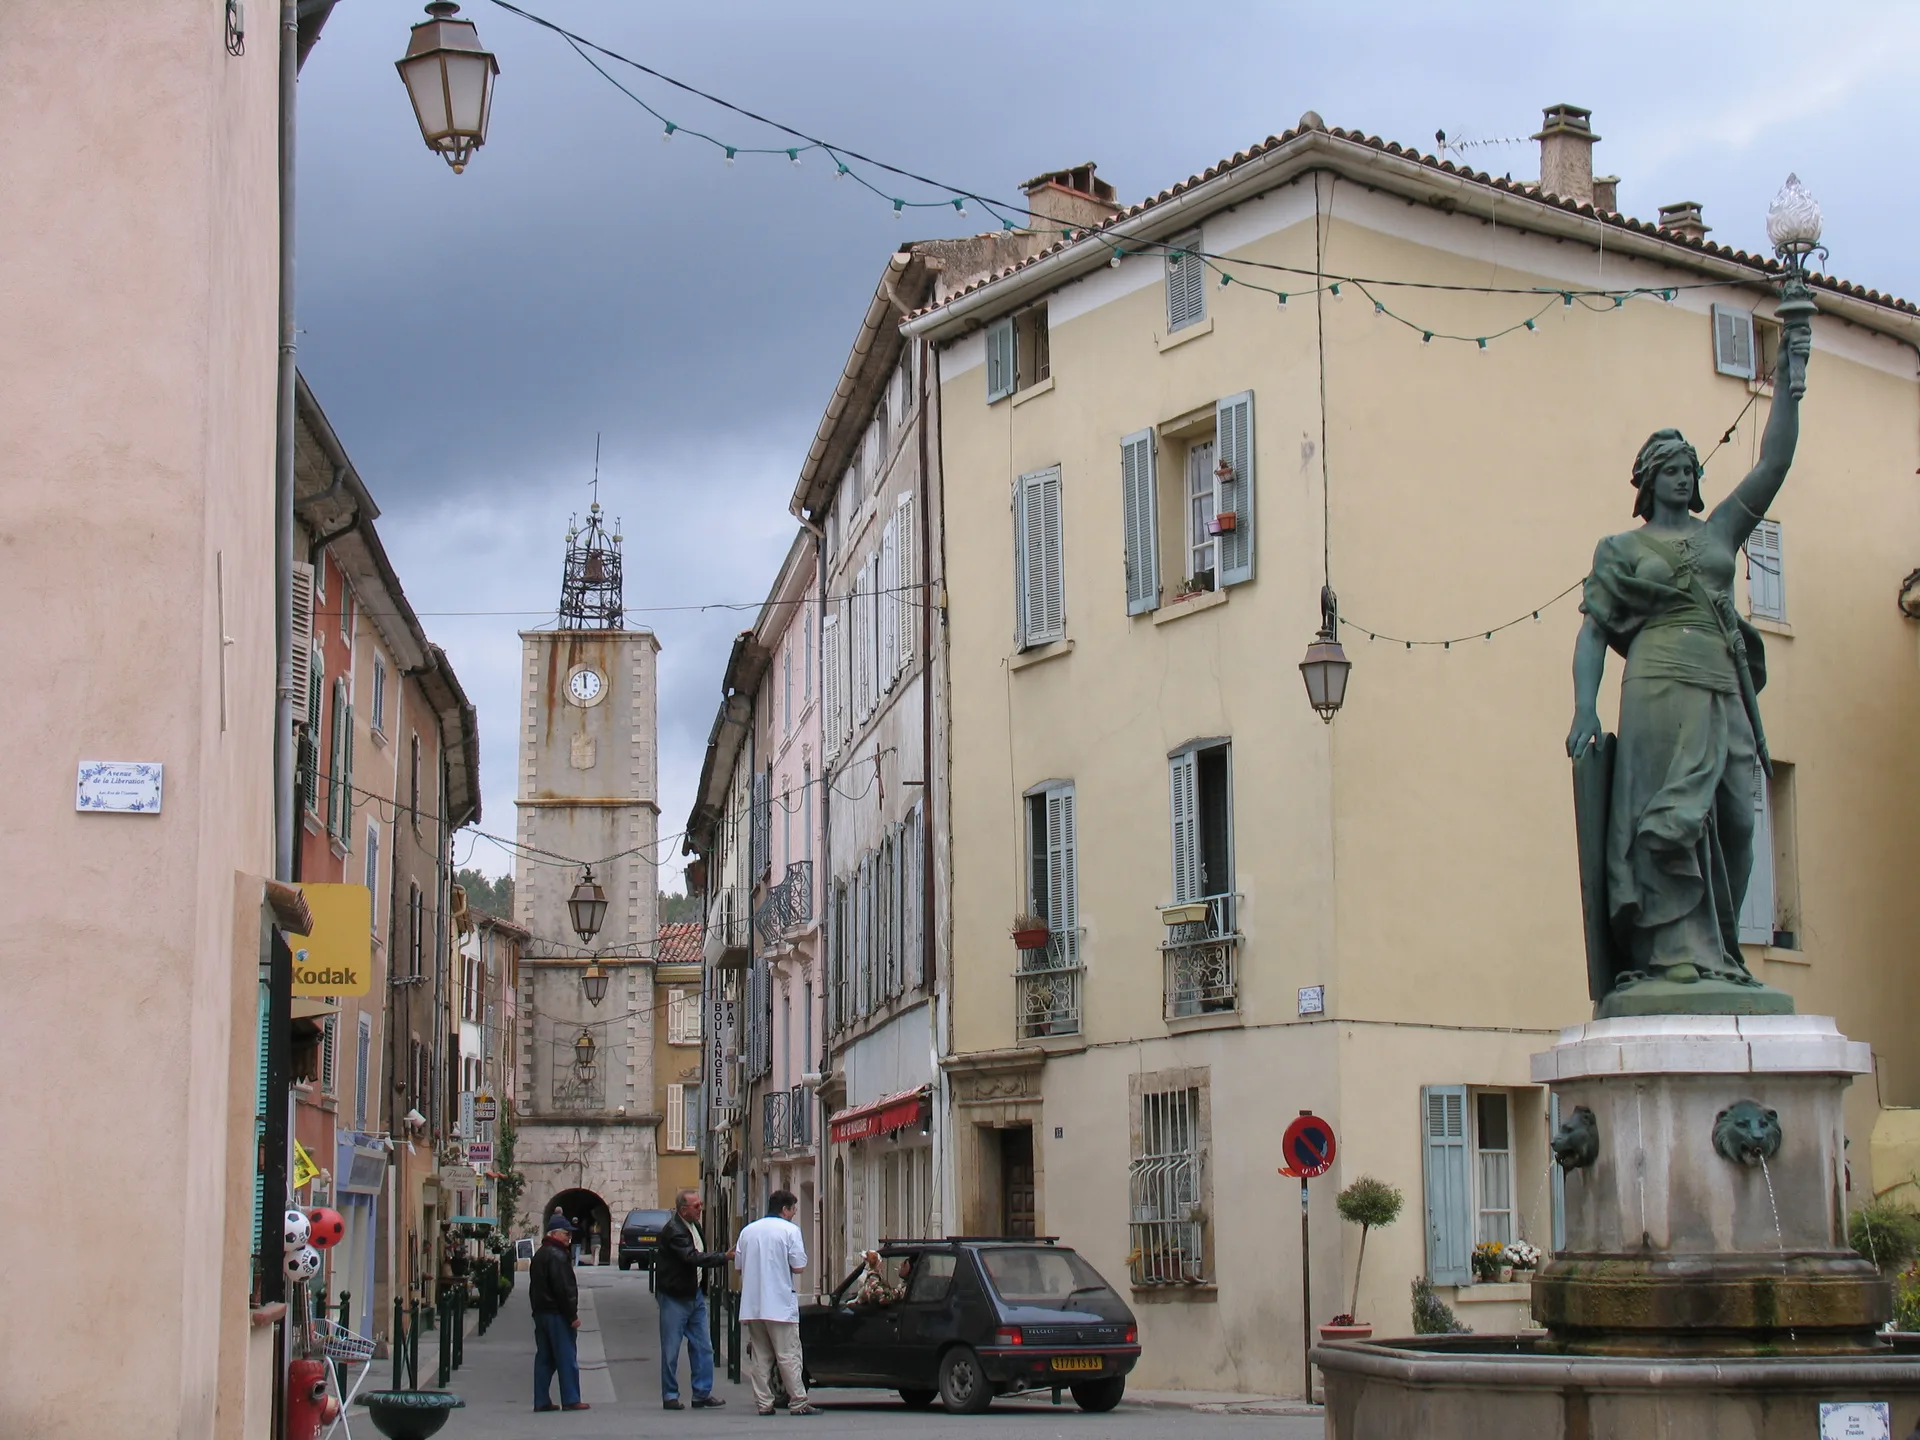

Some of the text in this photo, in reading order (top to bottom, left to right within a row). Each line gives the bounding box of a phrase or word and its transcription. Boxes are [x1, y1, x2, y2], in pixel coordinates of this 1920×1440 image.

[291, 967, 357, 984] Kodak
[714, 1003, 722, 1106] BOULANGERIE
[302, 1250, 314, 1274] CORNER
